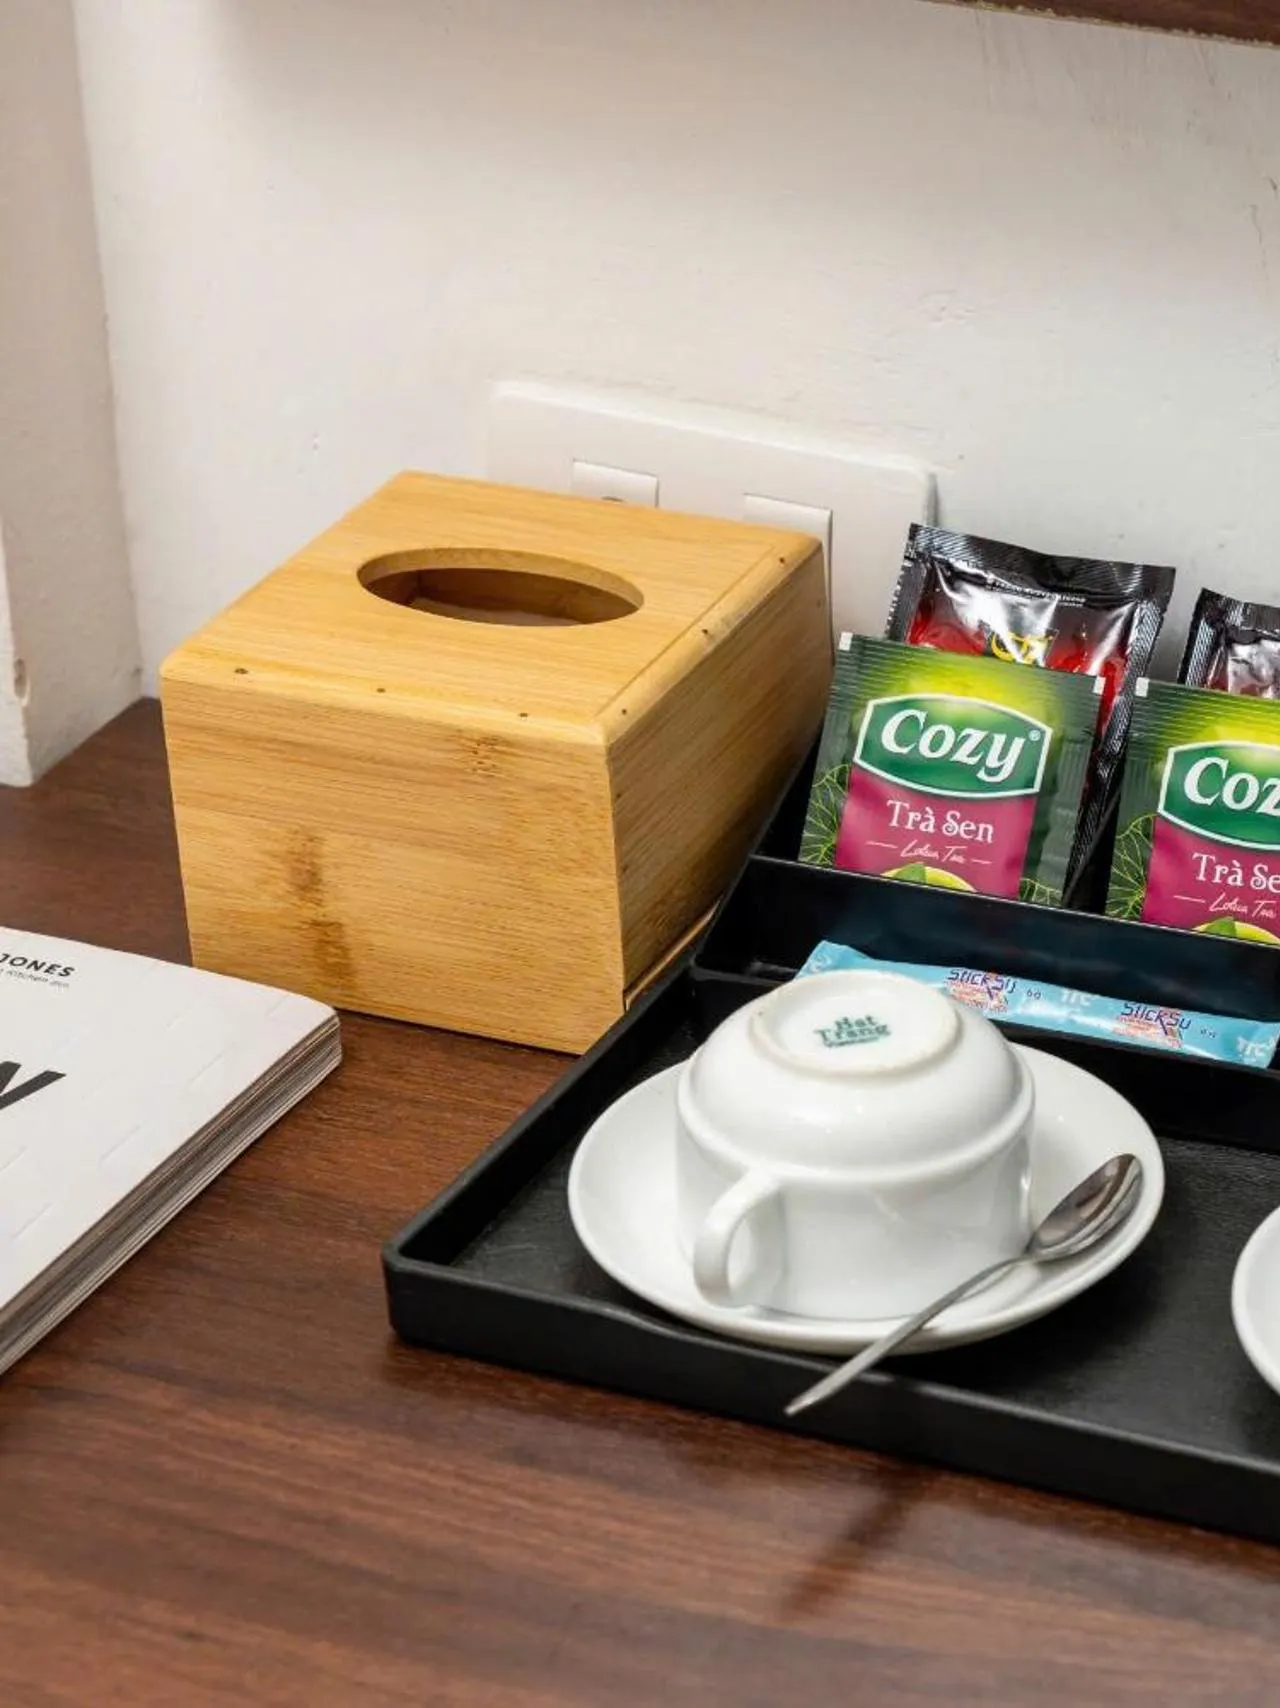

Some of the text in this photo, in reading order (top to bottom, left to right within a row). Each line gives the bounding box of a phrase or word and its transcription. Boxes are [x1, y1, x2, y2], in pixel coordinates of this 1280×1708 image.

[881, 708, 1026, 783] Cozy
[886, 799, 994, 843] Trà Sen
[1192, 853, 1243, 888] Trà
[0, 953, 75, 977] JONES
